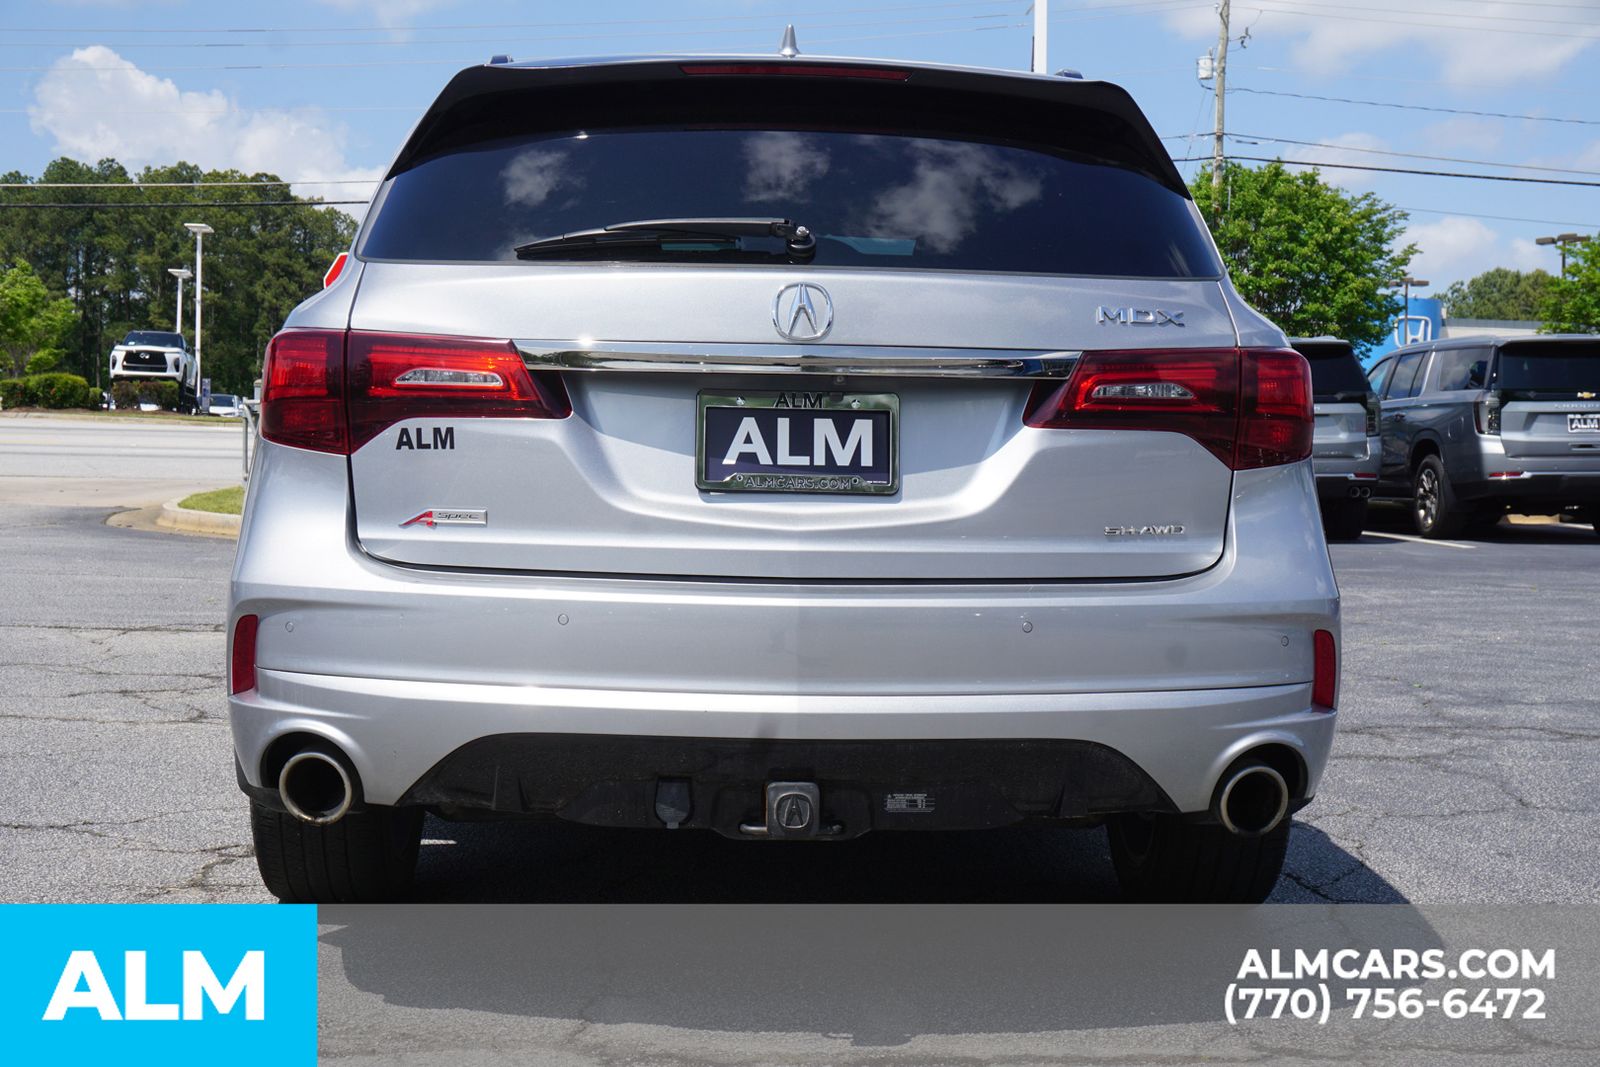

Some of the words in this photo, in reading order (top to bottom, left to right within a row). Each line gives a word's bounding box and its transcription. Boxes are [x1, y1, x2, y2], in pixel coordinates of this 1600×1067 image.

[1096, 305, 1185, 327] MDX
[775, 392, 823, 409] ALM
[1571, 418, 1599, 429] ALM
[395, 426, 455, 450] ALM
[721, 416, 873, 467] ALM
[744, 474, 851, 490] ALMCARS.COM
